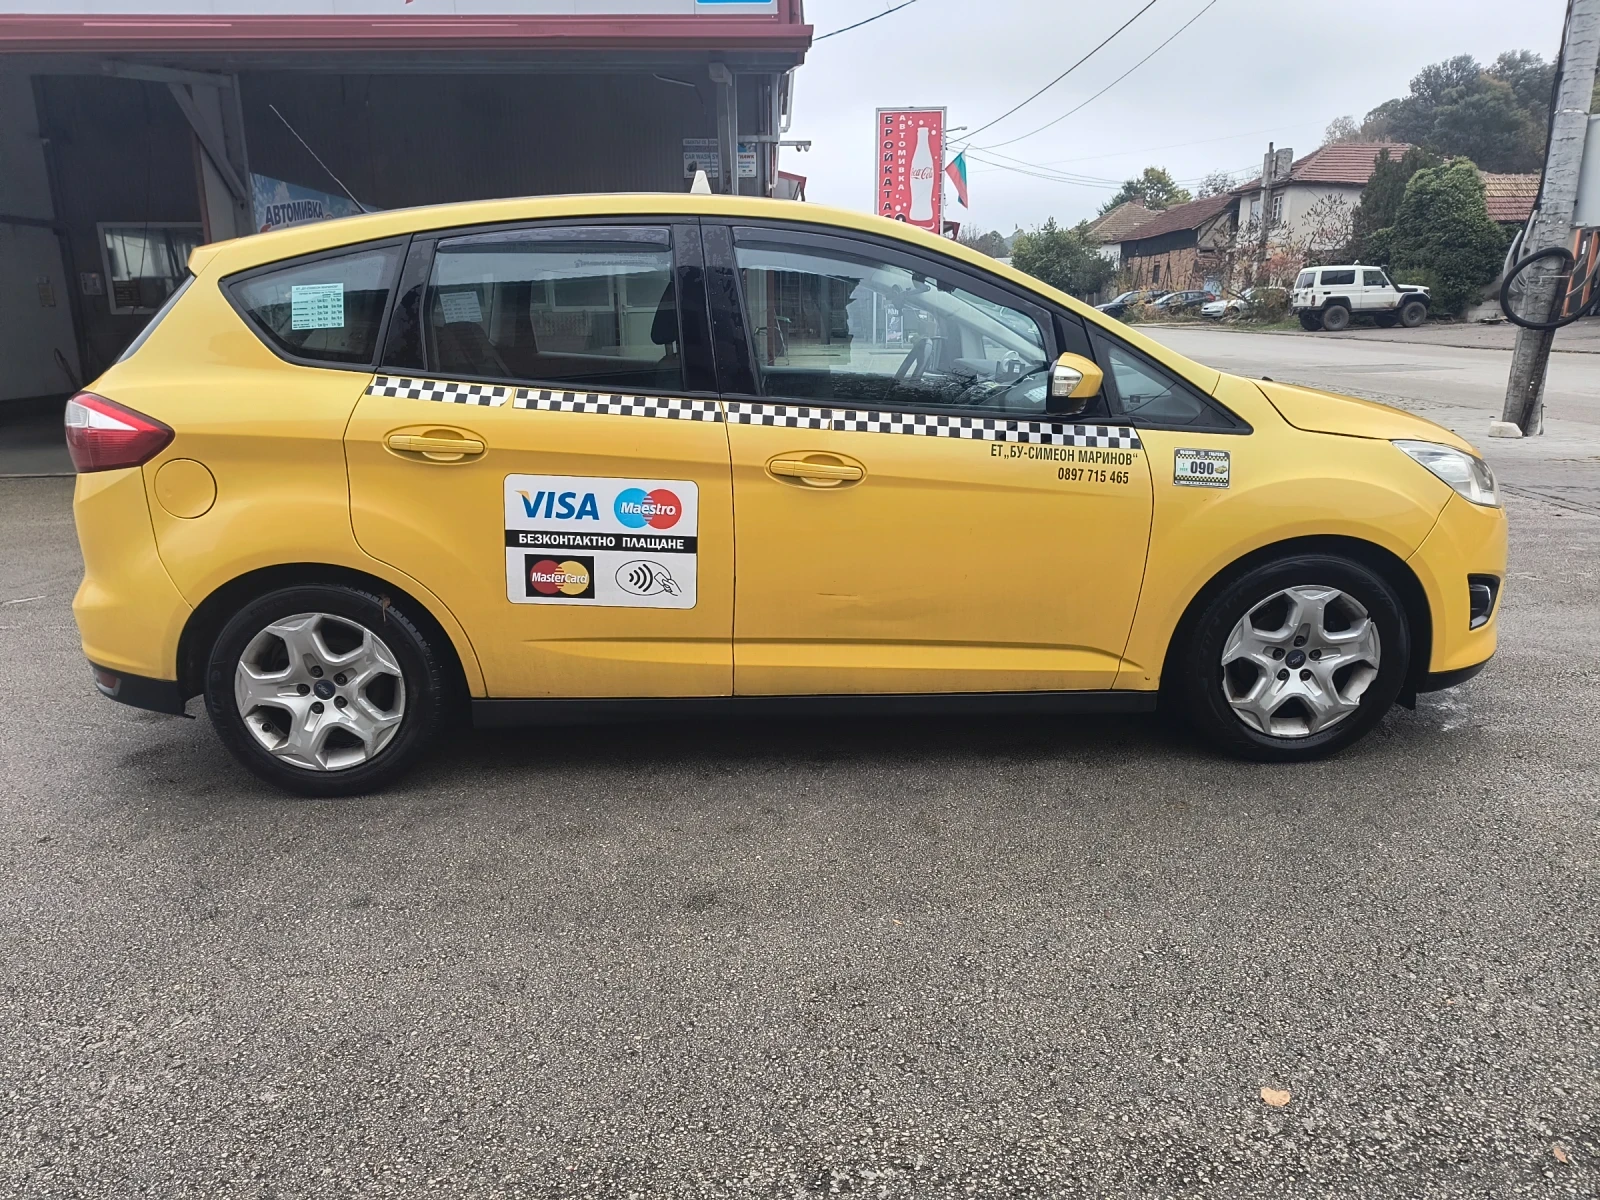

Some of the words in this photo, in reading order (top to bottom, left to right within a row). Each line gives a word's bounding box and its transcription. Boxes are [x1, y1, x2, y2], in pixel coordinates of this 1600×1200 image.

[897, 114, 906, 190] АВТОМИВКА
[883, 115, 893, 211] БРОЙКАТА
[266, 202, 324, 226] АВТОМИВКА
[1058, 467, 1084, 481] 0897
[1087, 469, 1106, 483] 715
[1109, 471, 1129, 484] 465
[1191, 461, 1214, 475] 090
[514, 490, 600, 521] VISA
[620, 501, 677, 516] Maestro
[518, 533, 616, 547] БЕЗКОНТАКТНО
[622, 537, 684, 550] ПЛАЩАНЕ
[531, 572, 589, 584] MasterCard
